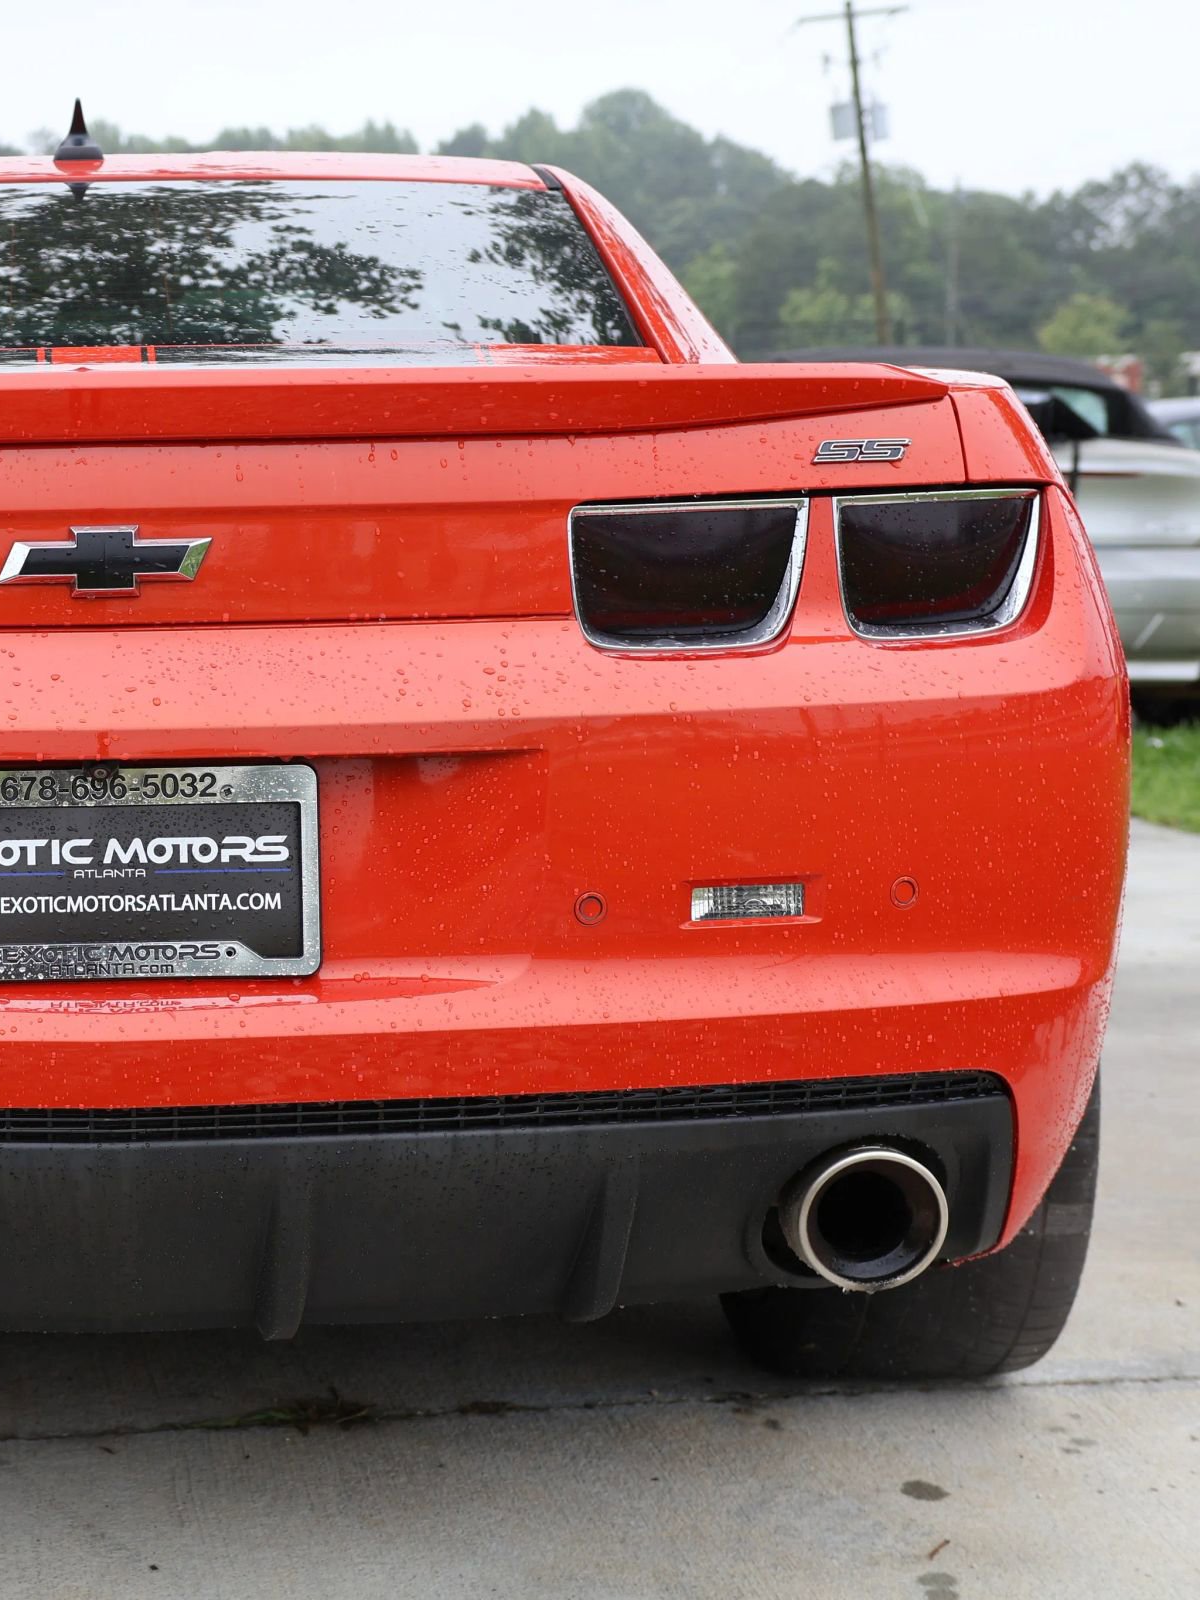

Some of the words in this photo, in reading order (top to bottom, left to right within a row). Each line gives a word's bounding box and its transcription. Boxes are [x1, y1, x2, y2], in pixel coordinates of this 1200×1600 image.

[812, 438, 912, 463] SS
[0, 773, 217, 801] 678-696-5032
[103, 835, 290, 864] MOTORS
[73, 869, 146, 879] ATLANTA
[2, 945, 101, 964] EXOTIC
[108, 944, 221, 961] MOTORS
[50, 962, 174, 976] ATLANTA.com
